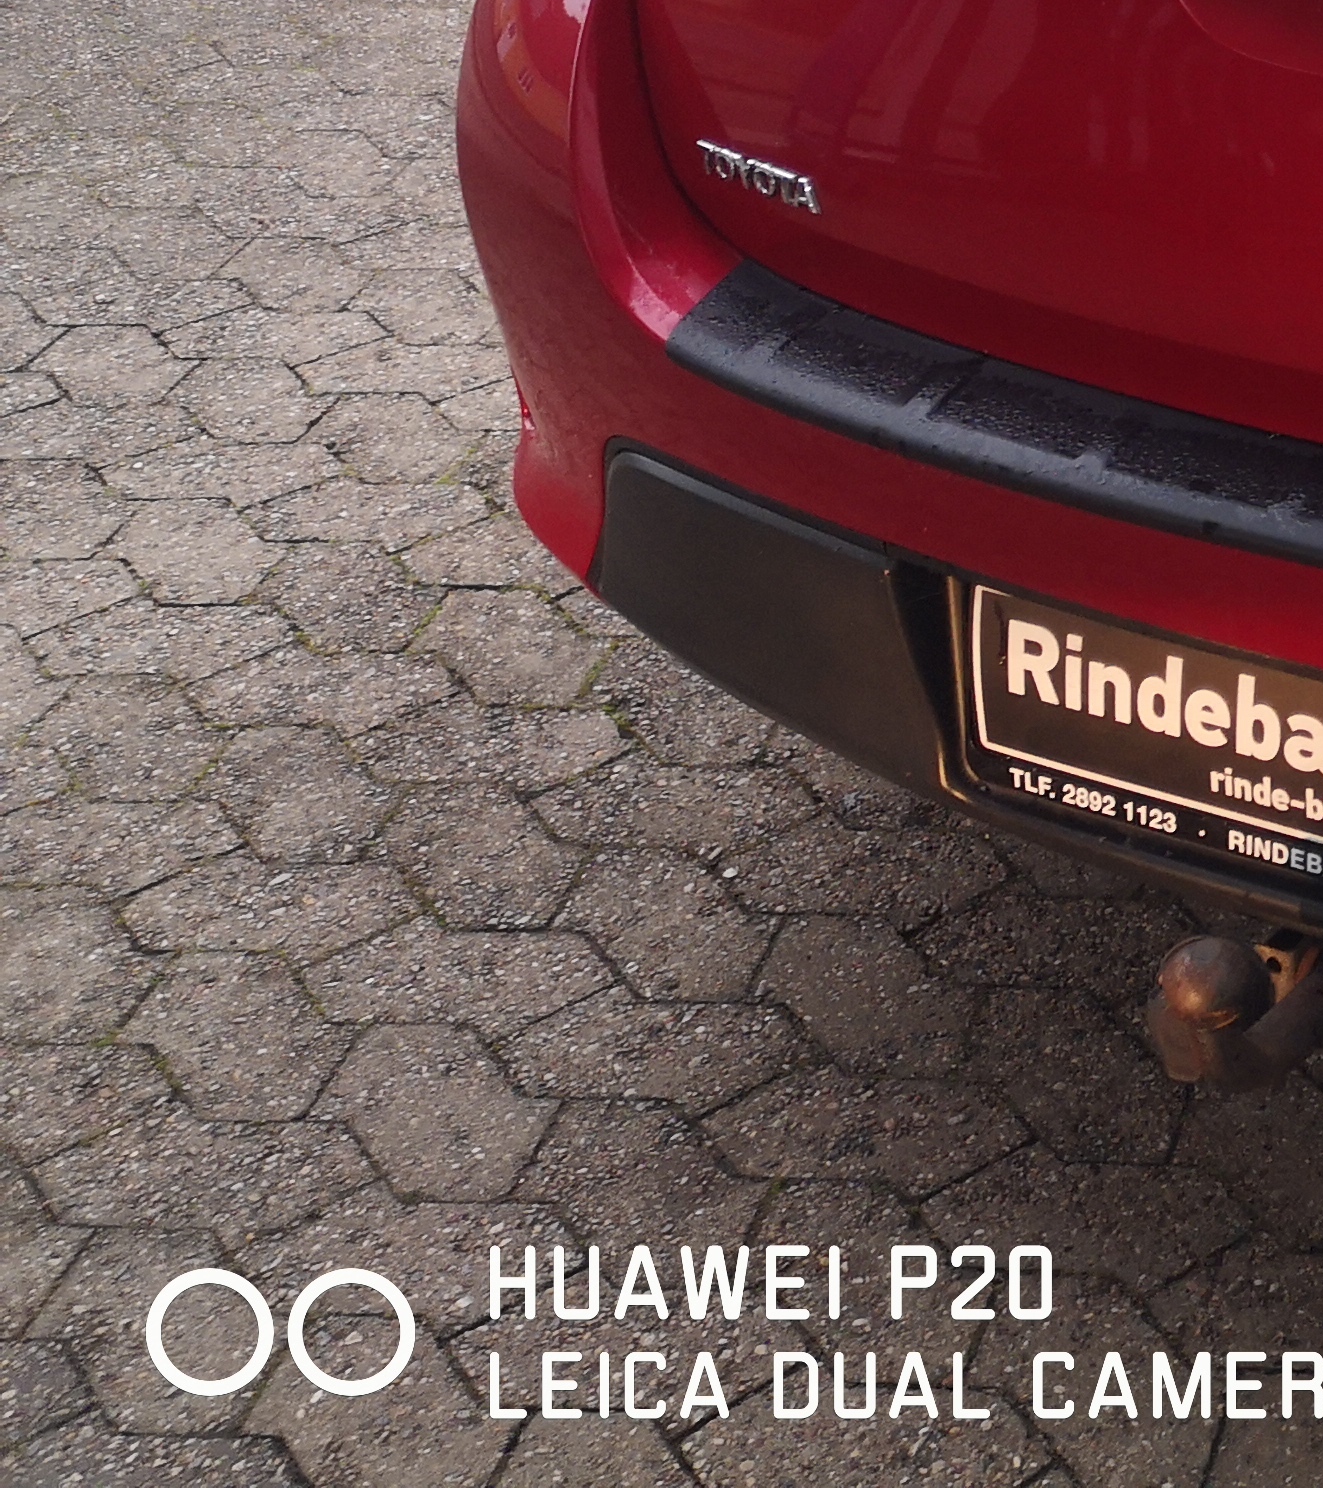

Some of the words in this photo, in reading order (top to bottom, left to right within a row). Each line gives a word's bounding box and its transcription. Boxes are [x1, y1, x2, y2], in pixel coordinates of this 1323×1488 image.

[696, 138, 822, 214] TOYOTA
[1008, 767, 1057, 800] TLF.
[1061, 783, 1117, 817] 2892
[1122, 801, 1178, 834] 1123
